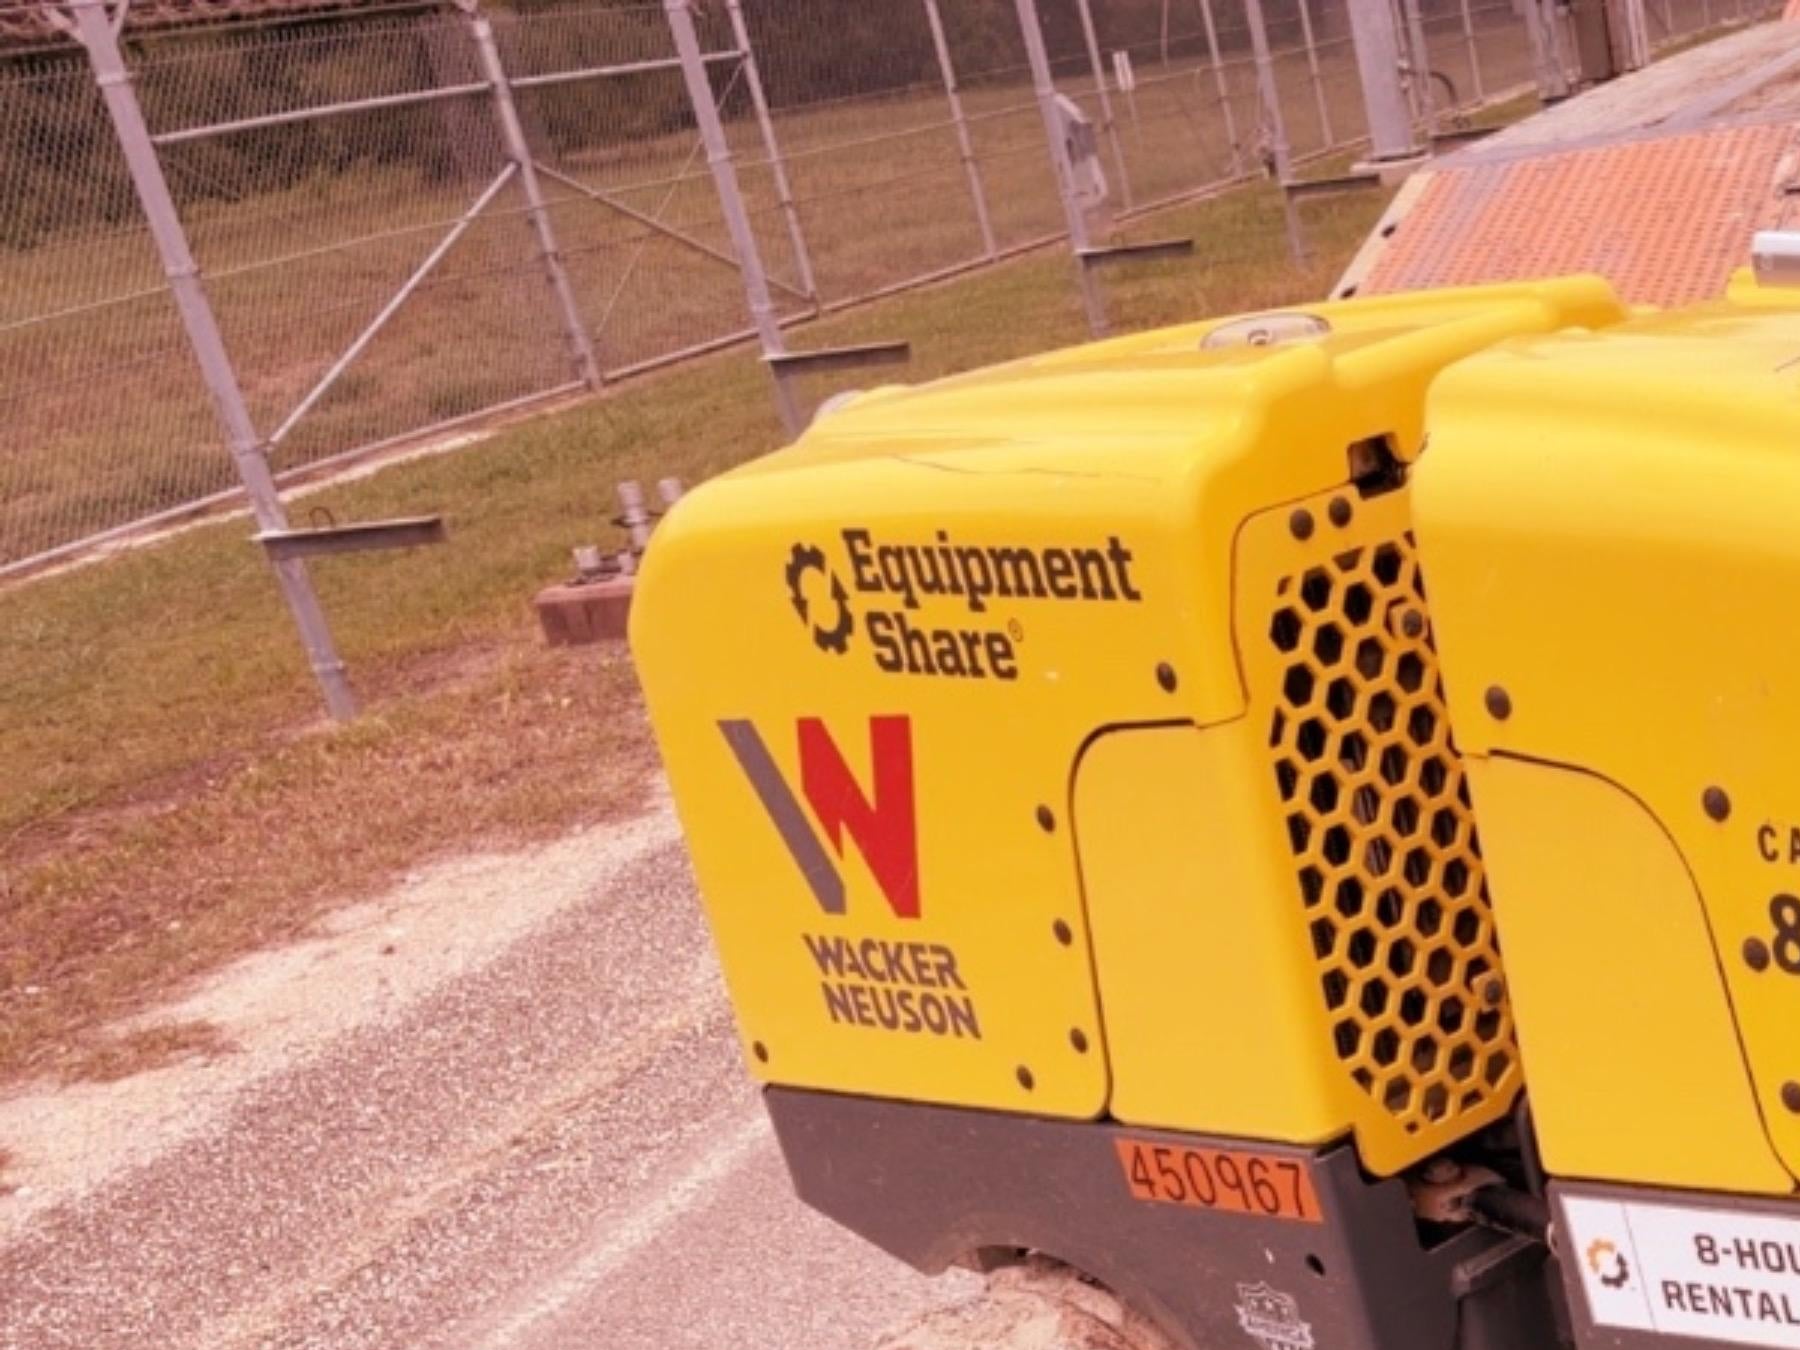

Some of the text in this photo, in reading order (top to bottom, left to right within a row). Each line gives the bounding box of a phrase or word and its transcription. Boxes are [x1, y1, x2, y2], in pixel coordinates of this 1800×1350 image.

[842, 528, 1143, 613] Equipment
[802, 932, 967, 991] WACKER
[821, 980, 982, 1040] NEUSON
[1130, 1145, 1307, 1218] 450967
